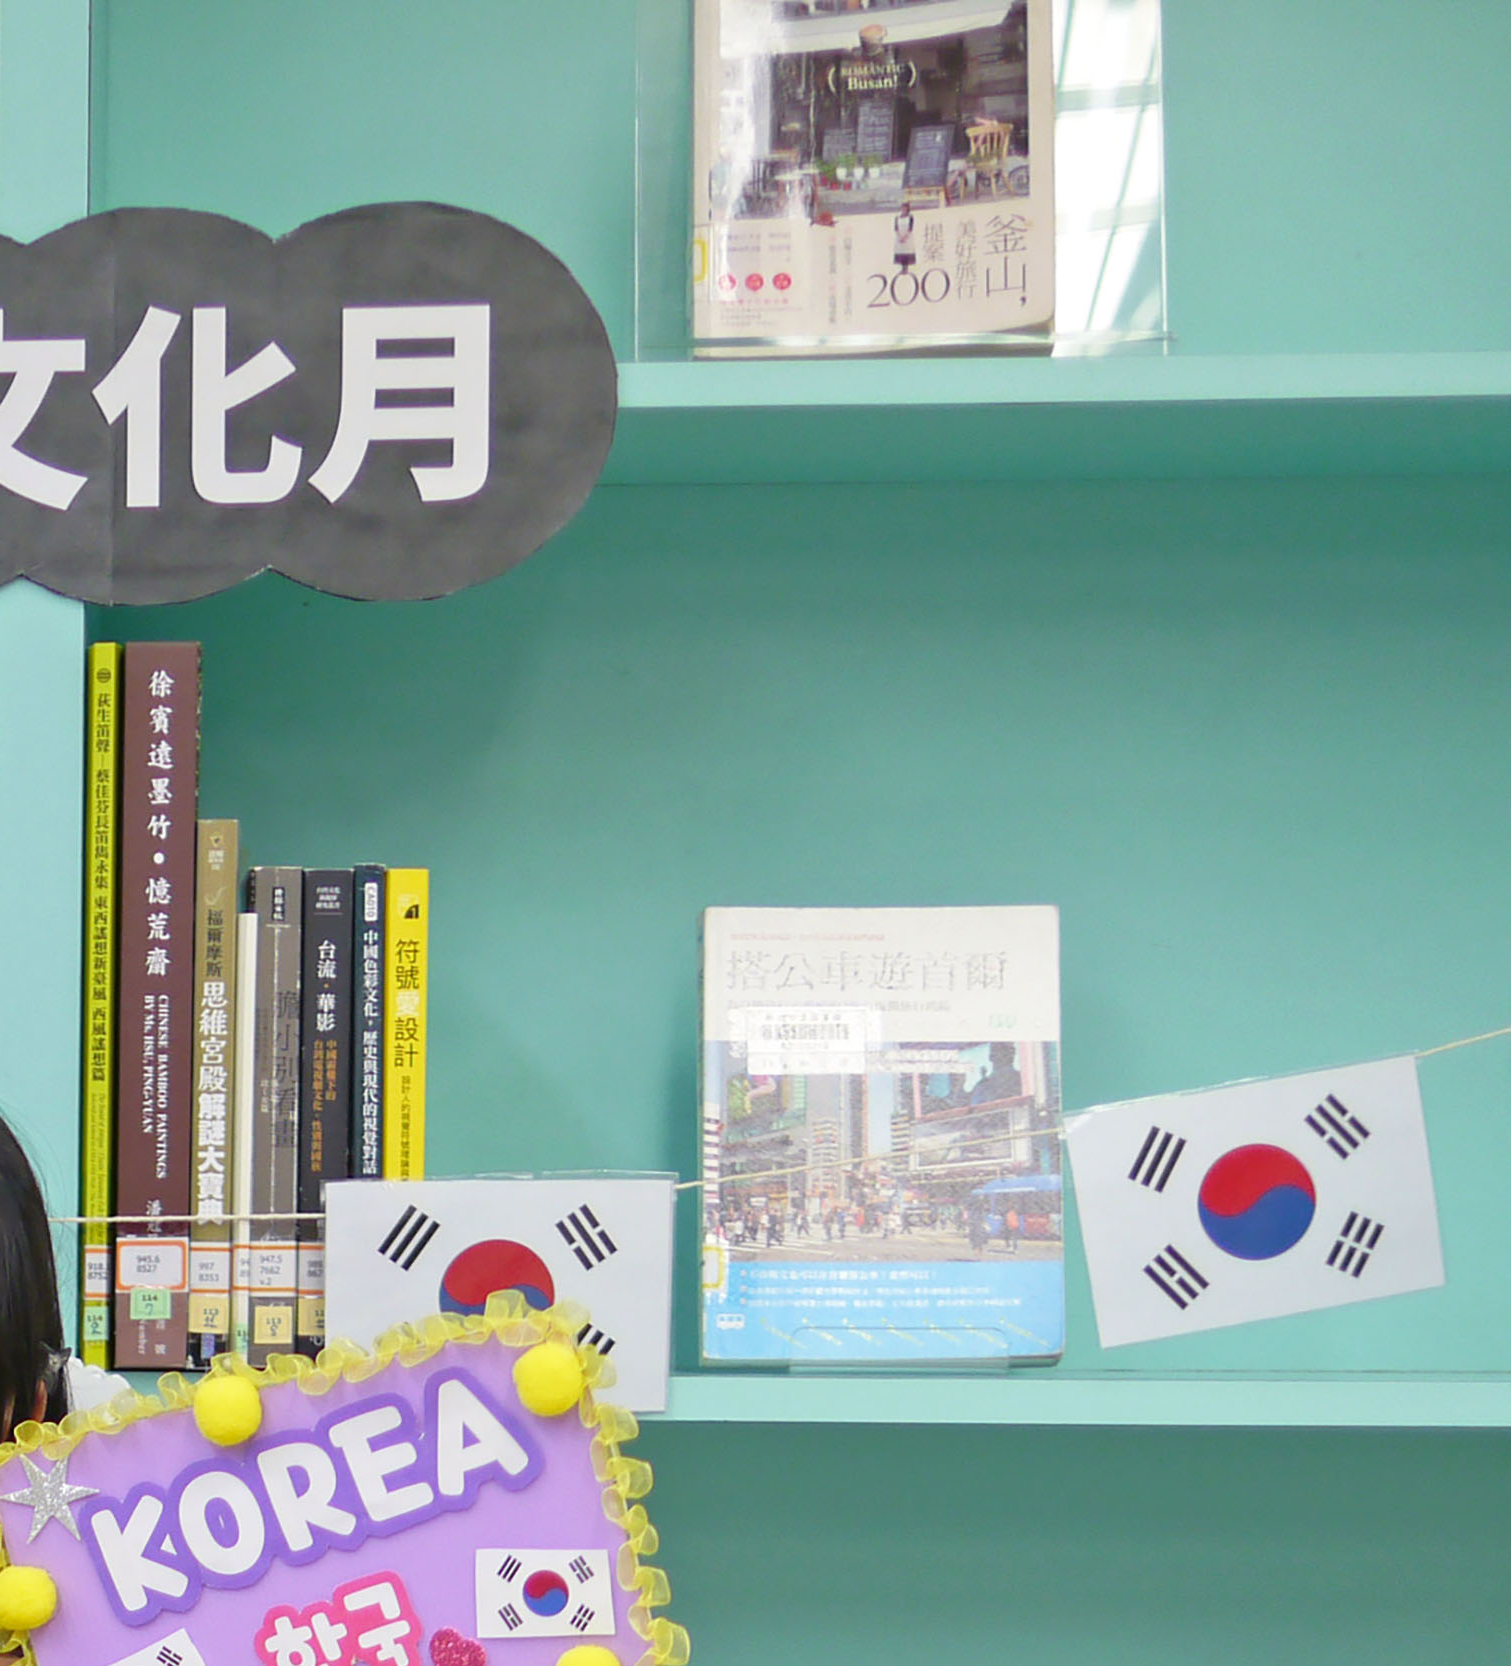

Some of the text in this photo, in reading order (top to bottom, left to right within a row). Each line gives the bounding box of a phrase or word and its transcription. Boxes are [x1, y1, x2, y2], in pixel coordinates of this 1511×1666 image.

[847, 76, 898, 91] Busan!
[866, 266, 951, 309] 200
[205, 908, 223, 977] 福爾摩斯
[726, 950, 1009, 991] 搭公車遊首爾
[395, 939, 420, 1068] 符號愛設計
[156, 994, 170, 1180] CHINESE BAMBOO PAINTINGS
[90, 1378, 529, 1612] KOREA
